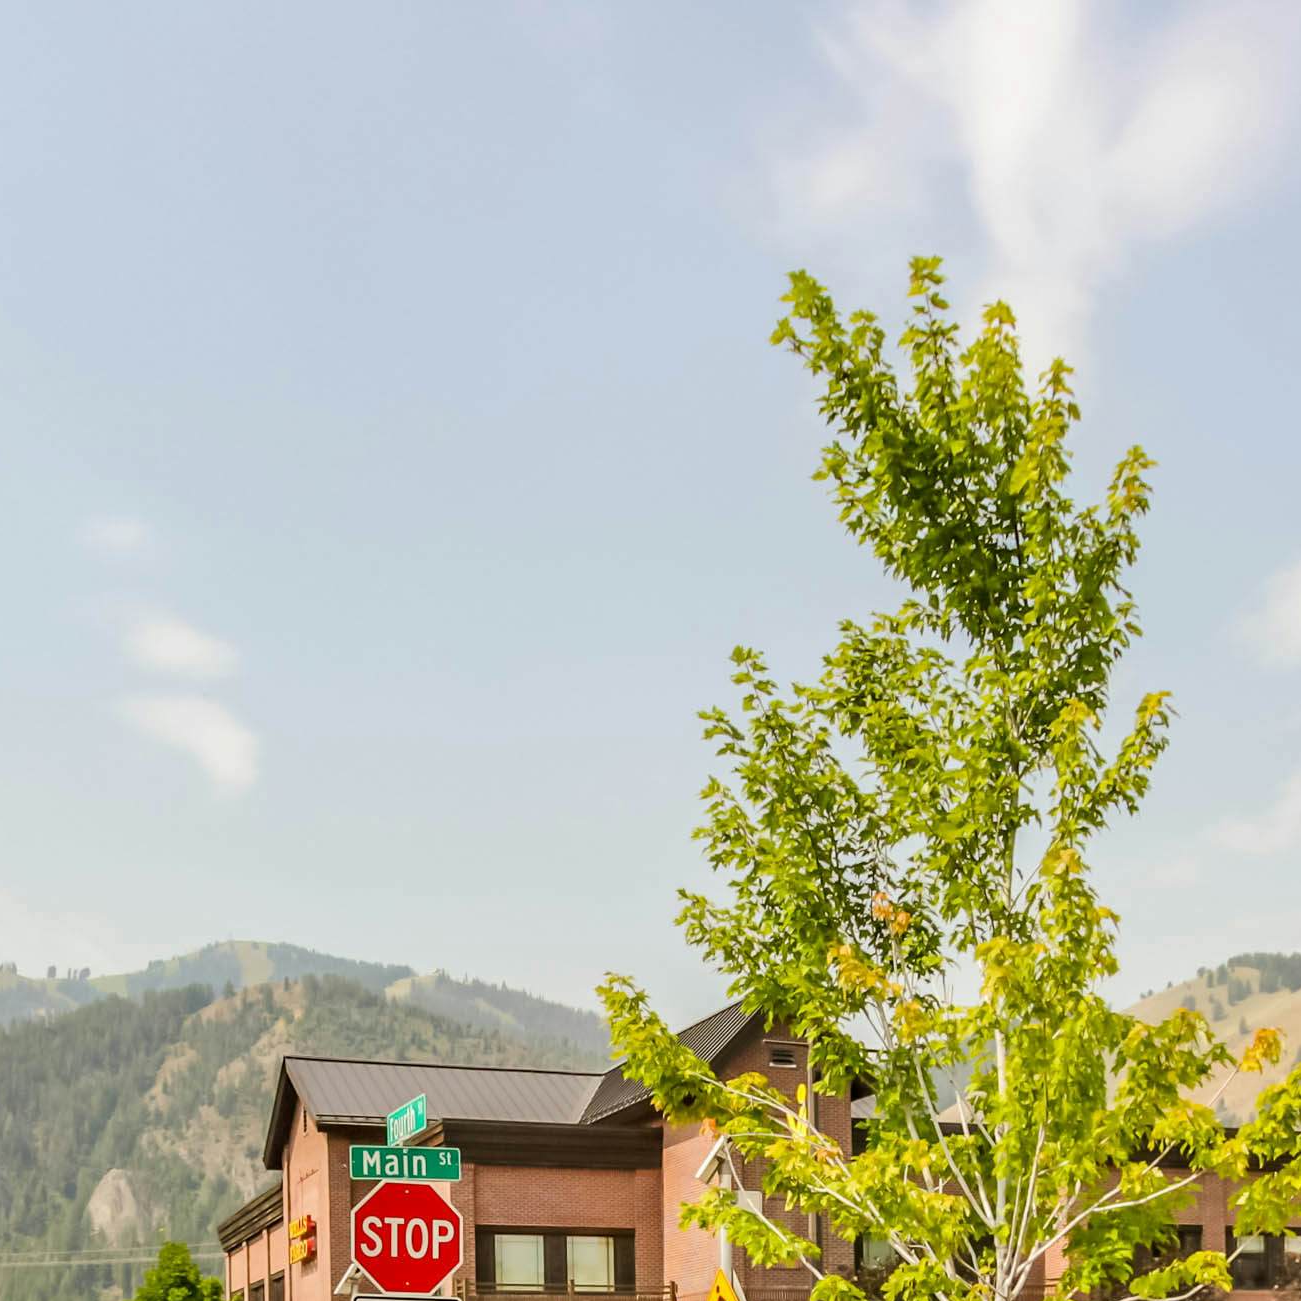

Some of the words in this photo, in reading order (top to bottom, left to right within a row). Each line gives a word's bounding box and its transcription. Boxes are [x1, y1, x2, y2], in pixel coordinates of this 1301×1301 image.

[362, 1148, 427, 1178] Main
[439, 1152, 452, 1166] St
[360, 1215, 455, 1260] STOP
